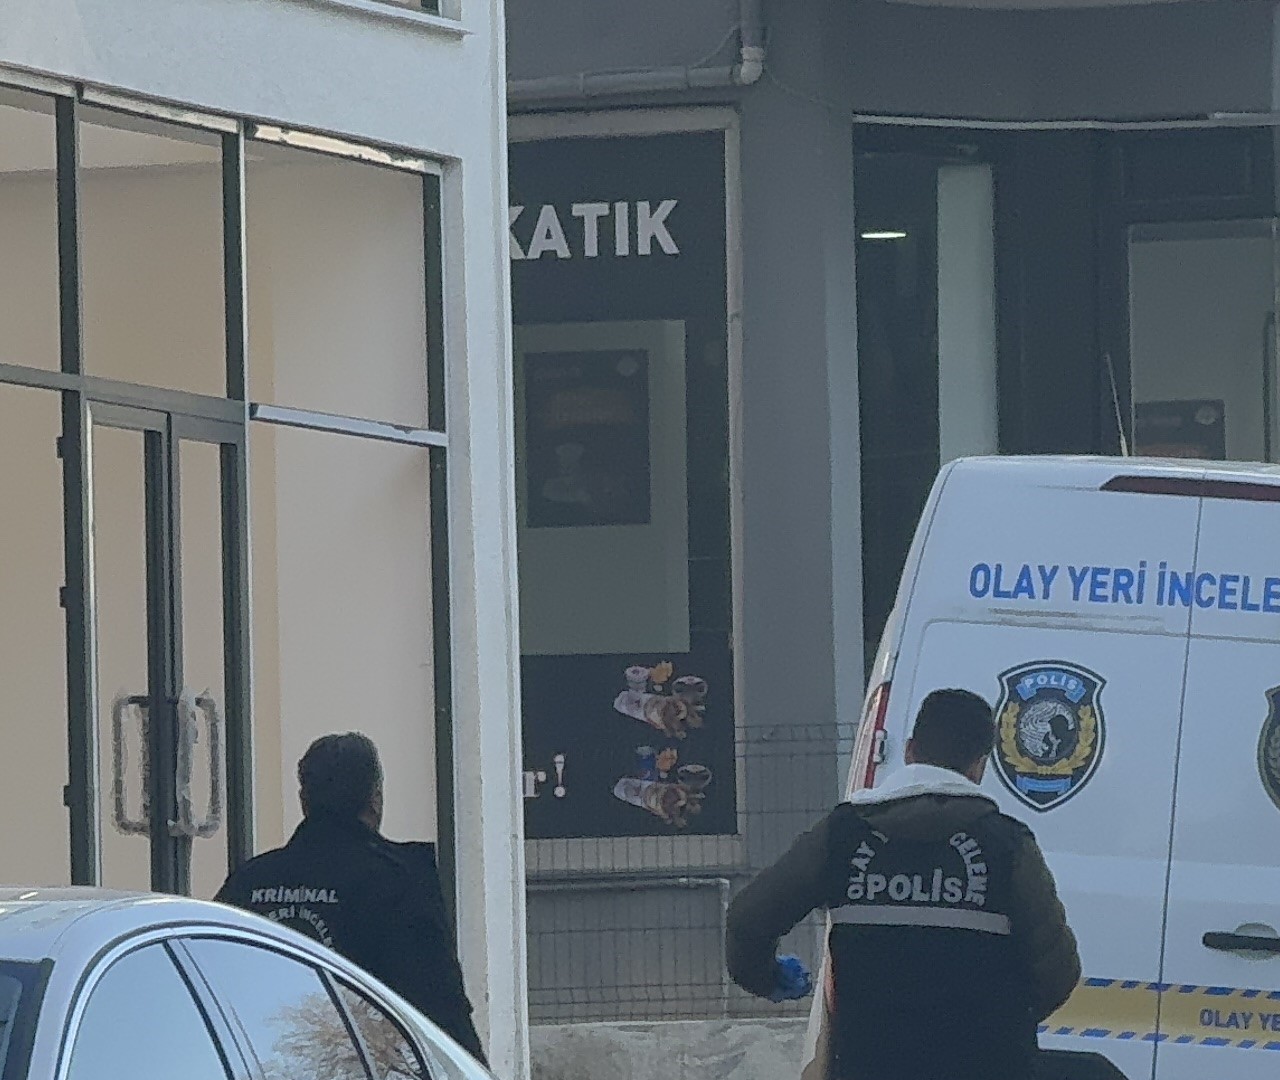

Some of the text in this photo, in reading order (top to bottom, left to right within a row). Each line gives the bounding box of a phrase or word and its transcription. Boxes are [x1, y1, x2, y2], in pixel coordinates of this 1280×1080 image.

[969, 562, 1060, 600] OLAY
[1068, 560, 1147, 605] YERİ
[523, 754, 566, 798] r!
[847, 841, 876, 900] OLAY
[866, 867, 963, 903] POLİS
[949, 832, 988, 907] CELEME
[251, 885, 339, 903] KRİMİNAL
[1200, 1008, 1254, 1030] OLAY
